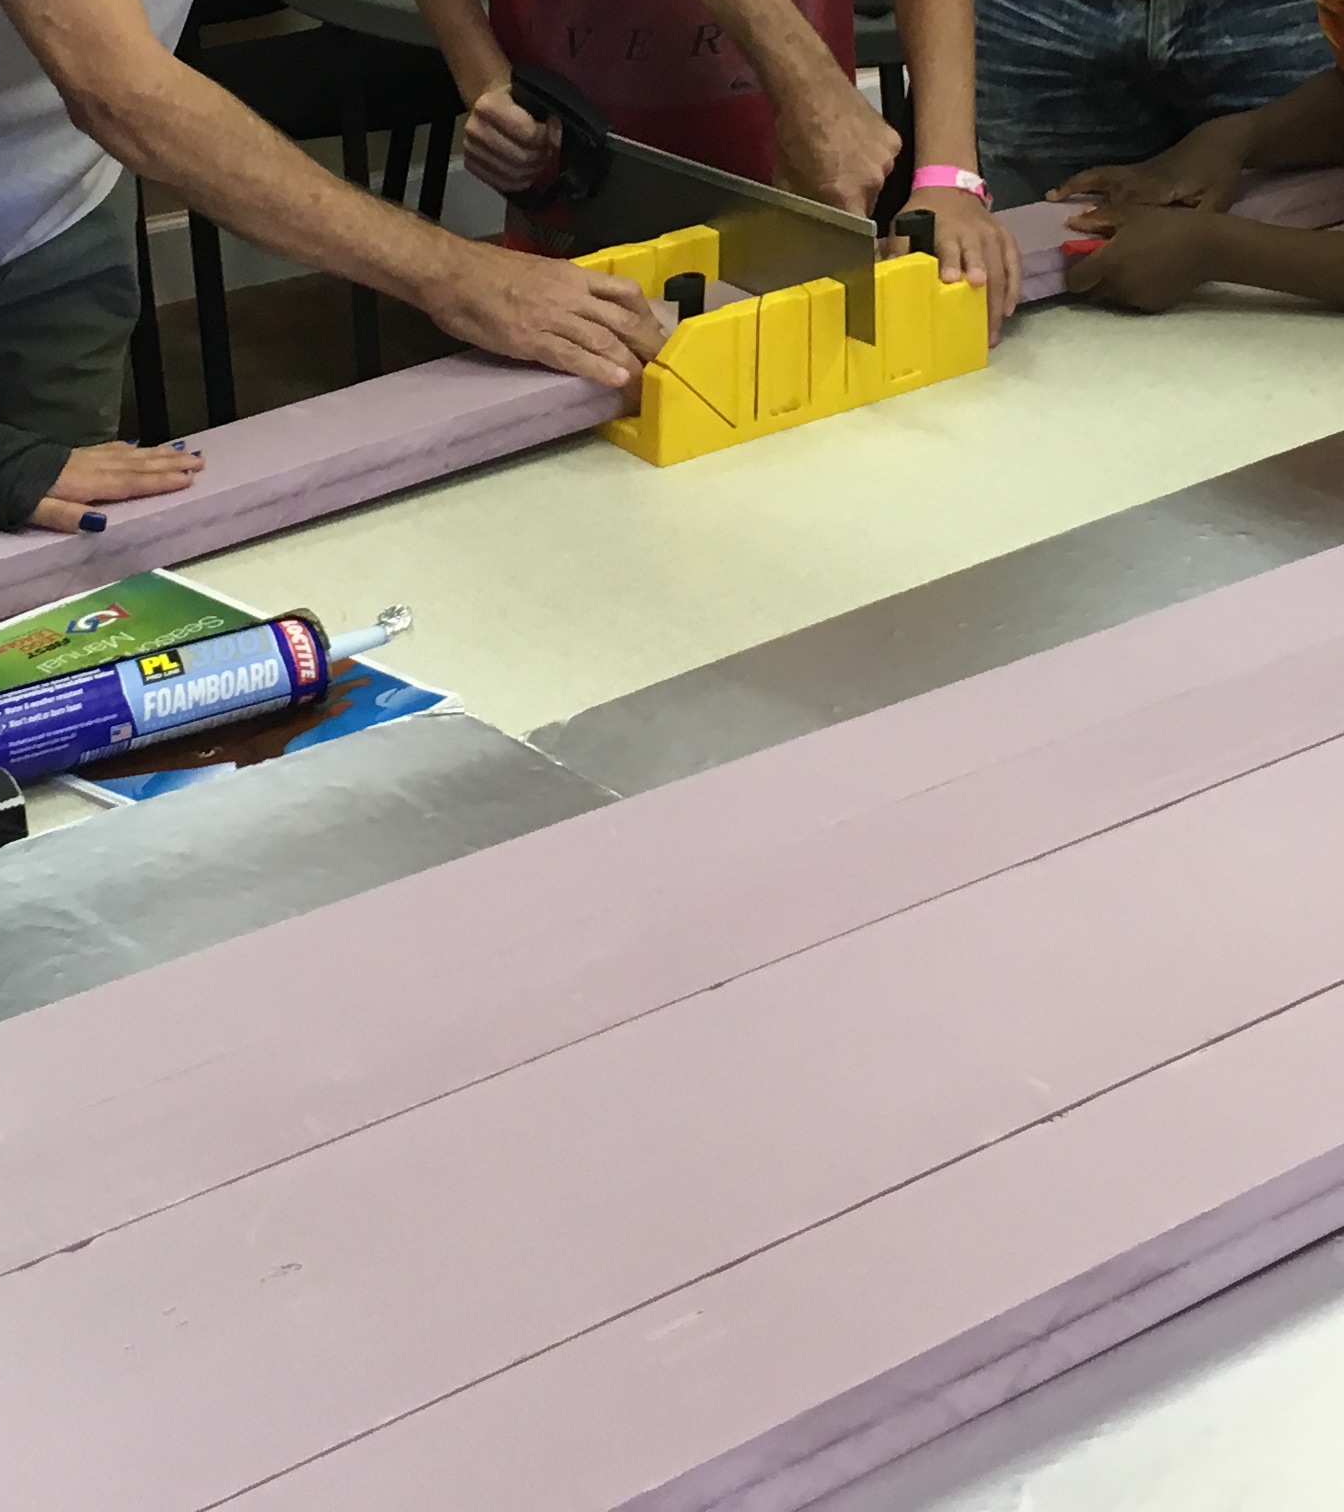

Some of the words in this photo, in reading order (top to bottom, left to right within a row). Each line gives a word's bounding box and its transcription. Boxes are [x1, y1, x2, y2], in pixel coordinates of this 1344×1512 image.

[37, 629, 136, 675] Manual
[141, 651, 180, 676] PL
[188, 631, 262, 668] 300
[278, 619, 316, 683] LOCTITE
[143, 659, 278, 719] FOAMBOARD
